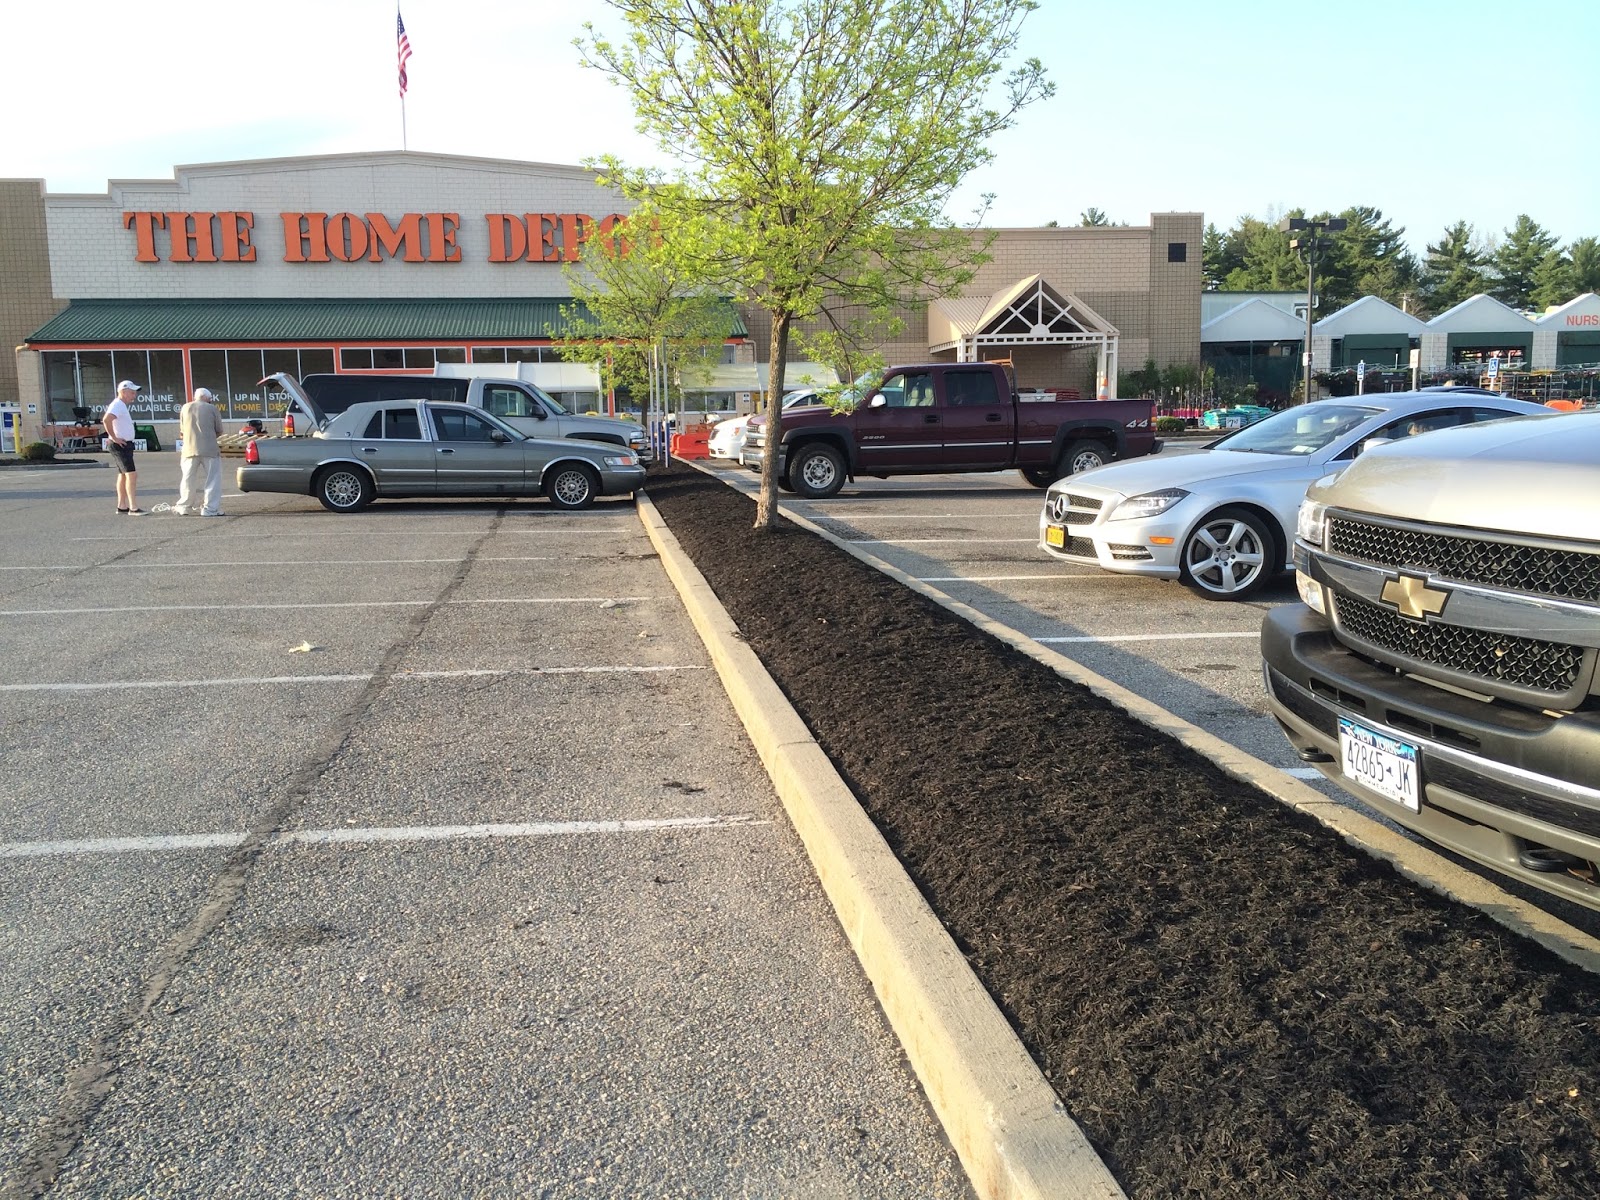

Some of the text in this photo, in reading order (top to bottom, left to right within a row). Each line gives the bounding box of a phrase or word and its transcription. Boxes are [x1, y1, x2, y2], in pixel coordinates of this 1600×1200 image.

[123, 211, 257, 263] THE
[280, 212, 462, 263] HOME
[1566, 314, 1600, 326] NURS
[137, 394, 174, 403] ONLINE
[234, 393, 248, 402] UP
[249, 393, 260, 401] IN
[127, 404, 172, 413] VAILABLE
[233, 403, 261, 412] HOME
